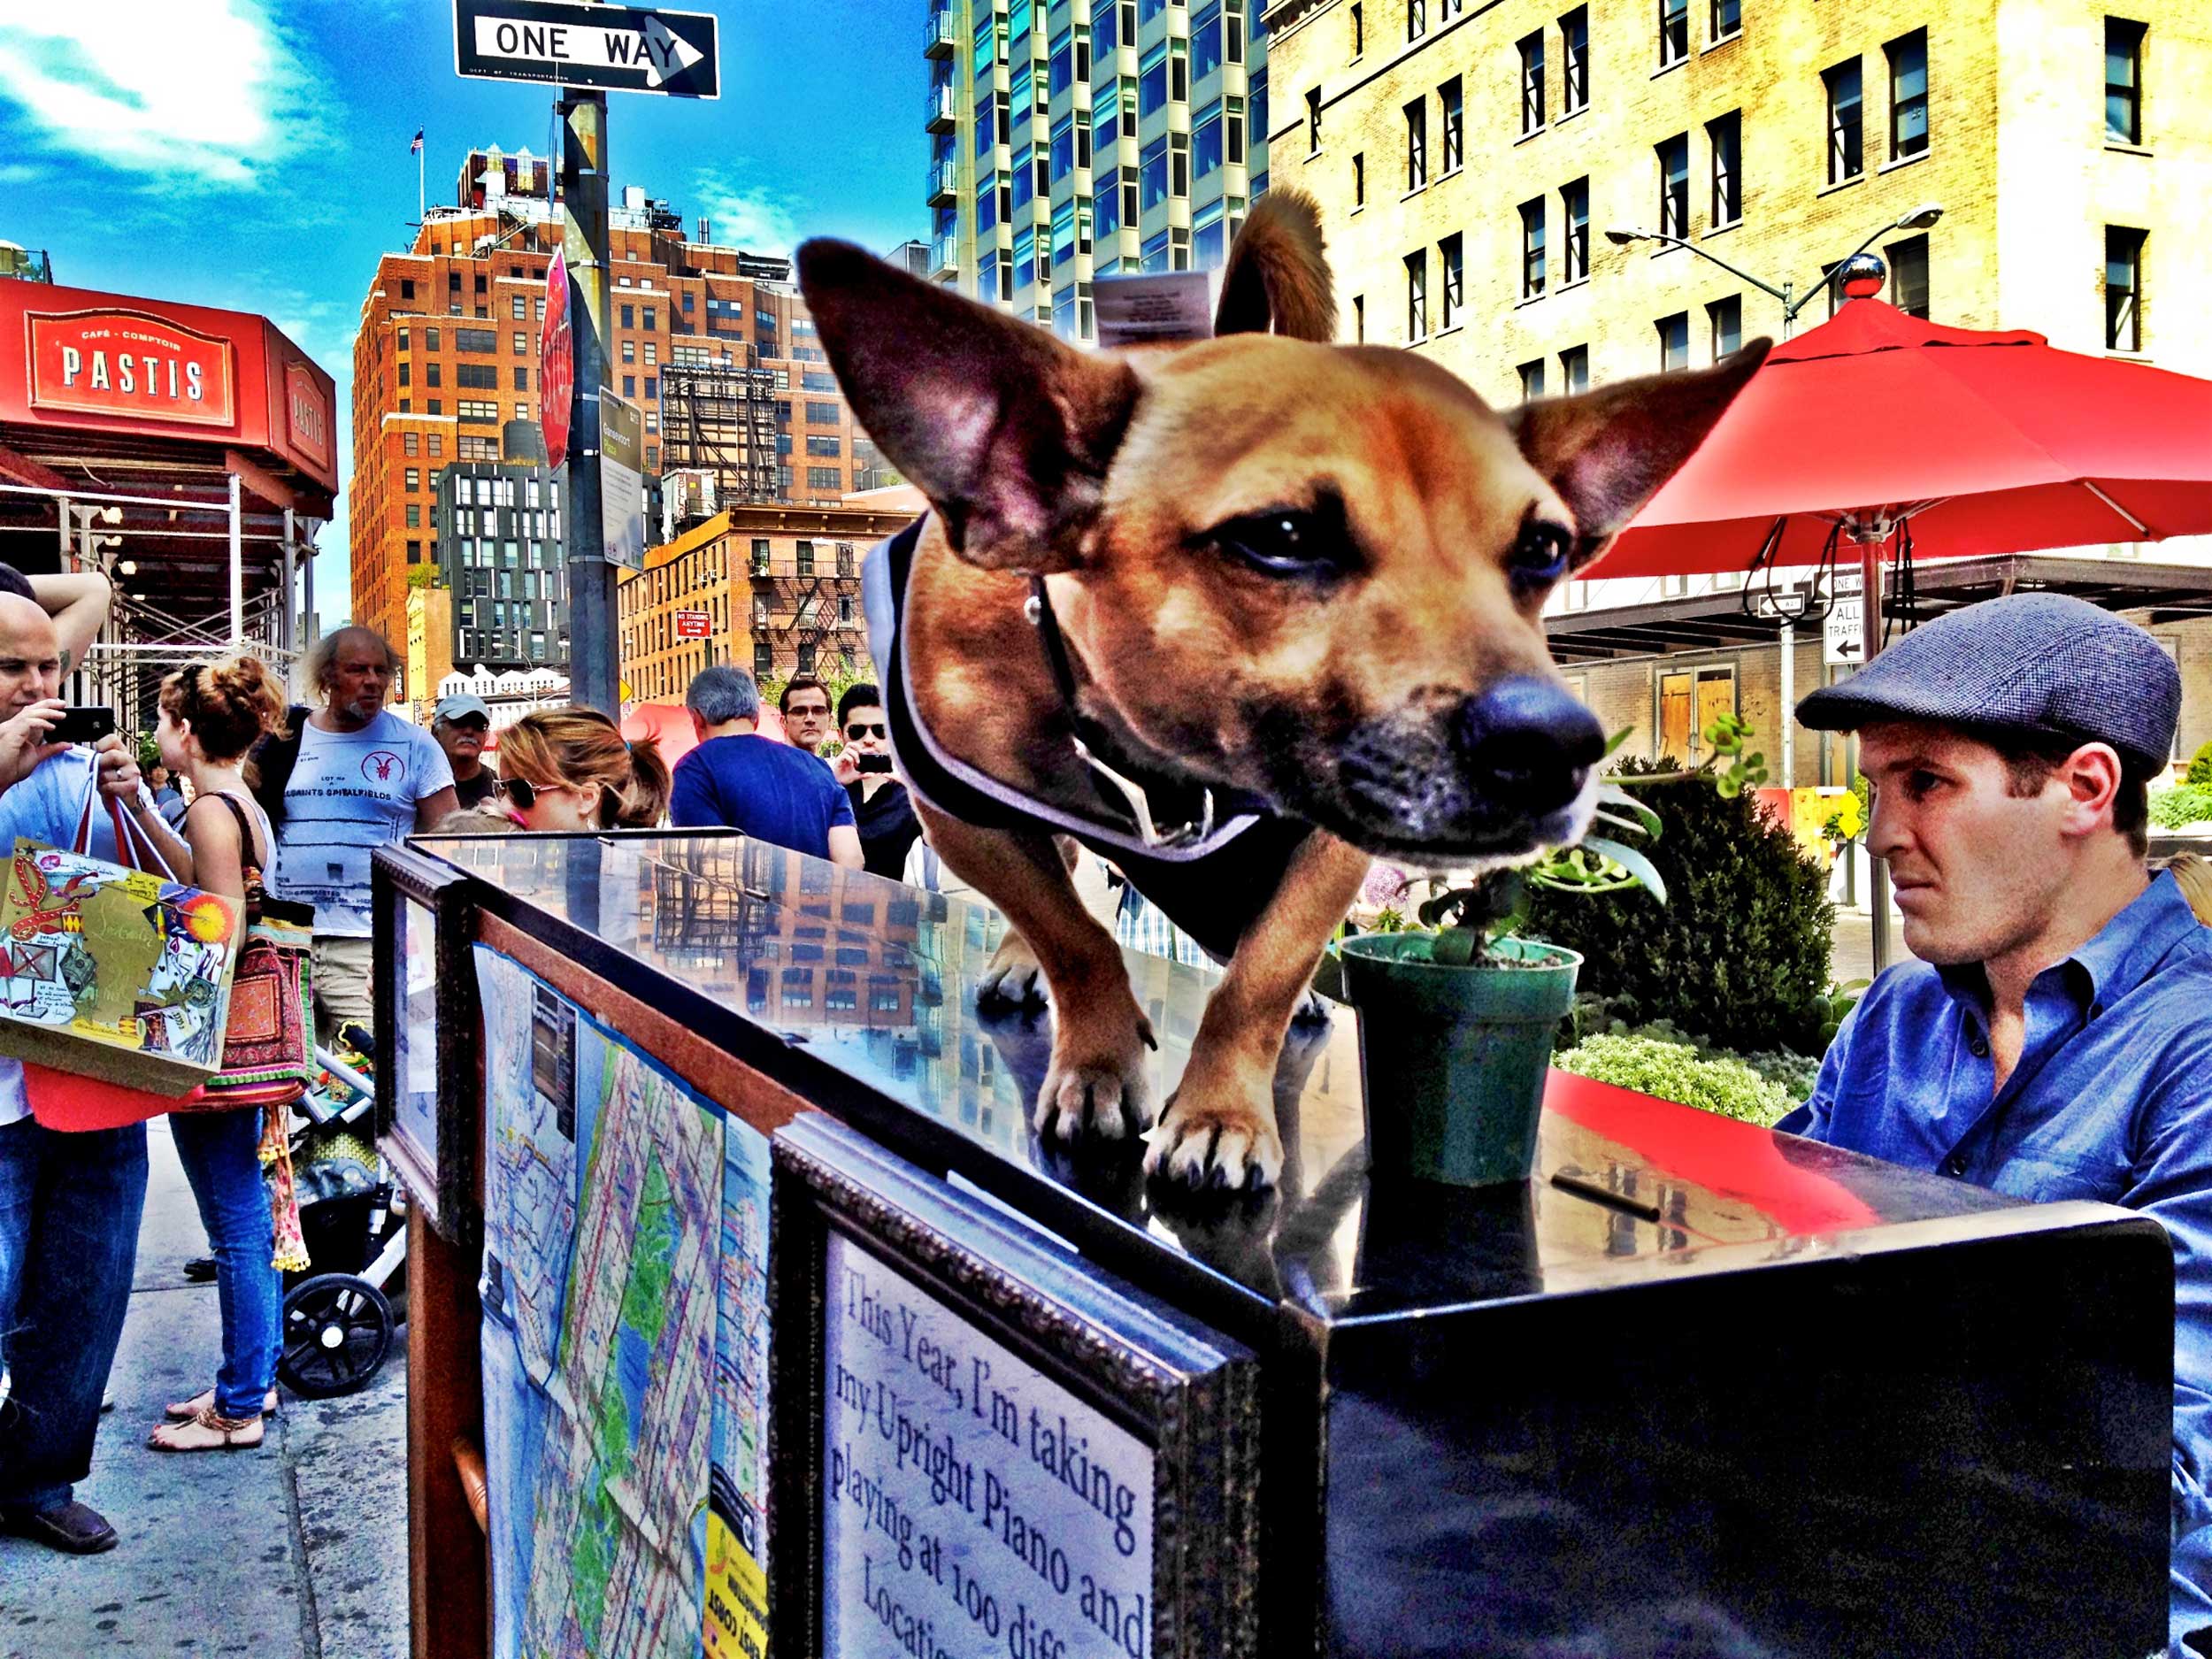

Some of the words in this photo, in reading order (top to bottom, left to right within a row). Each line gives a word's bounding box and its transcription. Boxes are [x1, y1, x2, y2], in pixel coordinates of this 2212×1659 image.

[496, 23, 570, 58] ONE
[604, 33, 678, 67] WAY
[122, 331, 181, 351] COMPTOIR
[543, 321, 570, 412] STOP
[62, 346, 204, 402] PASTIS
[293, 393, 322, 447] PASTIS
[1828, 624, 1862, 637] TRAFFI
[1836, 606, 1860, 621] ALL
[326, 788, 391, 800] SPITALFIELDS
[844, 1266, 892, 1346] This
[899, 1302, 964, 1410] Year,
[972, 1356, 1020, 1448] I'm
[1029, 1405, 1137, 1556] taking
[835, 1363, 871, 1434] my
[876, 1379, 975, 1513] Upright
[982, 1468, 1070, 1594] Piano
[1080, 1574, 1145, 1659] and
[831, 1442, 913, 1571] playing
[919, 1533, 944, 1586] at
[953, 1563, 999, 1638] 100
[864, 1554, 948, 1659] Locati
